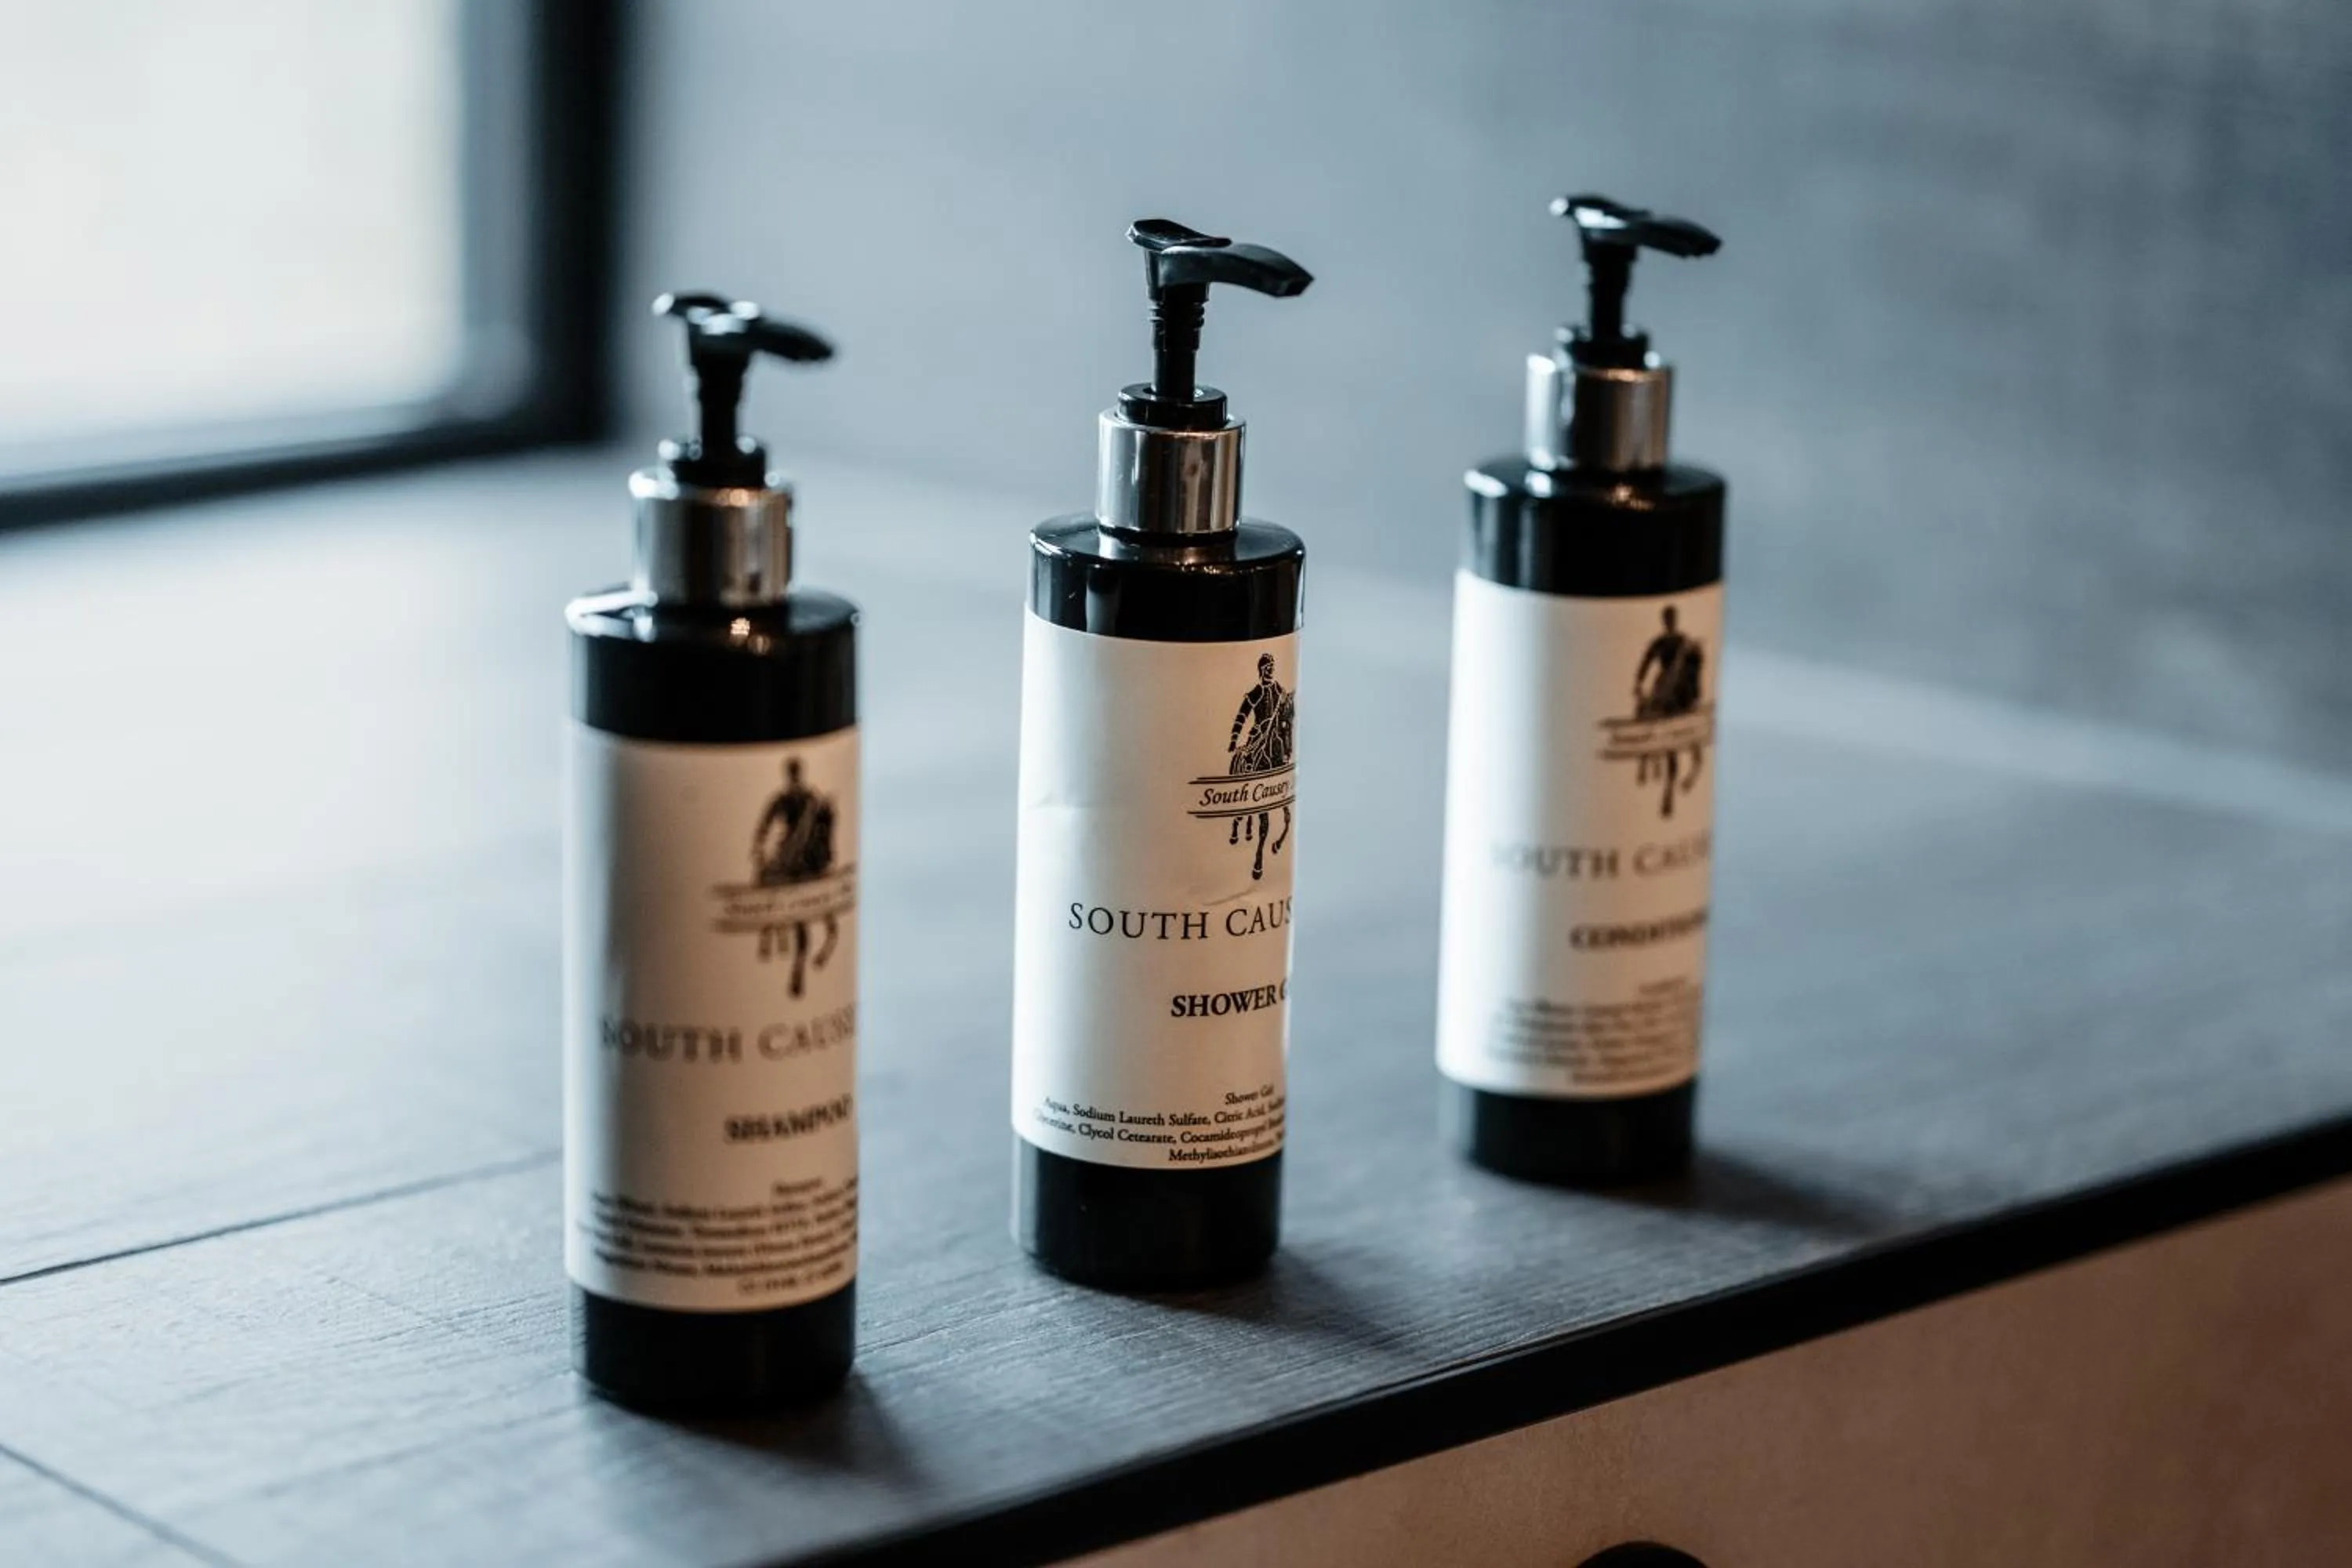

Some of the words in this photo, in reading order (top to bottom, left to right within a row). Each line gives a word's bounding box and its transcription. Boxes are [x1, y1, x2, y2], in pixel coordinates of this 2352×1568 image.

[1199, 783, 1249, 807] South
[1252, 781, 1290, 802] Causey
[1069, 902, 1209, 940] SOUTH
[1171, 984, 1276, 1018] SHOWER
[1073, 1103, 1116, 1122] Sodium
[1119, 1109, 1165, 1127] Laureth
[1168, 1112, 1211, 1127] Sulfate,
[1214, 1110, 1243, 1123] Citric
